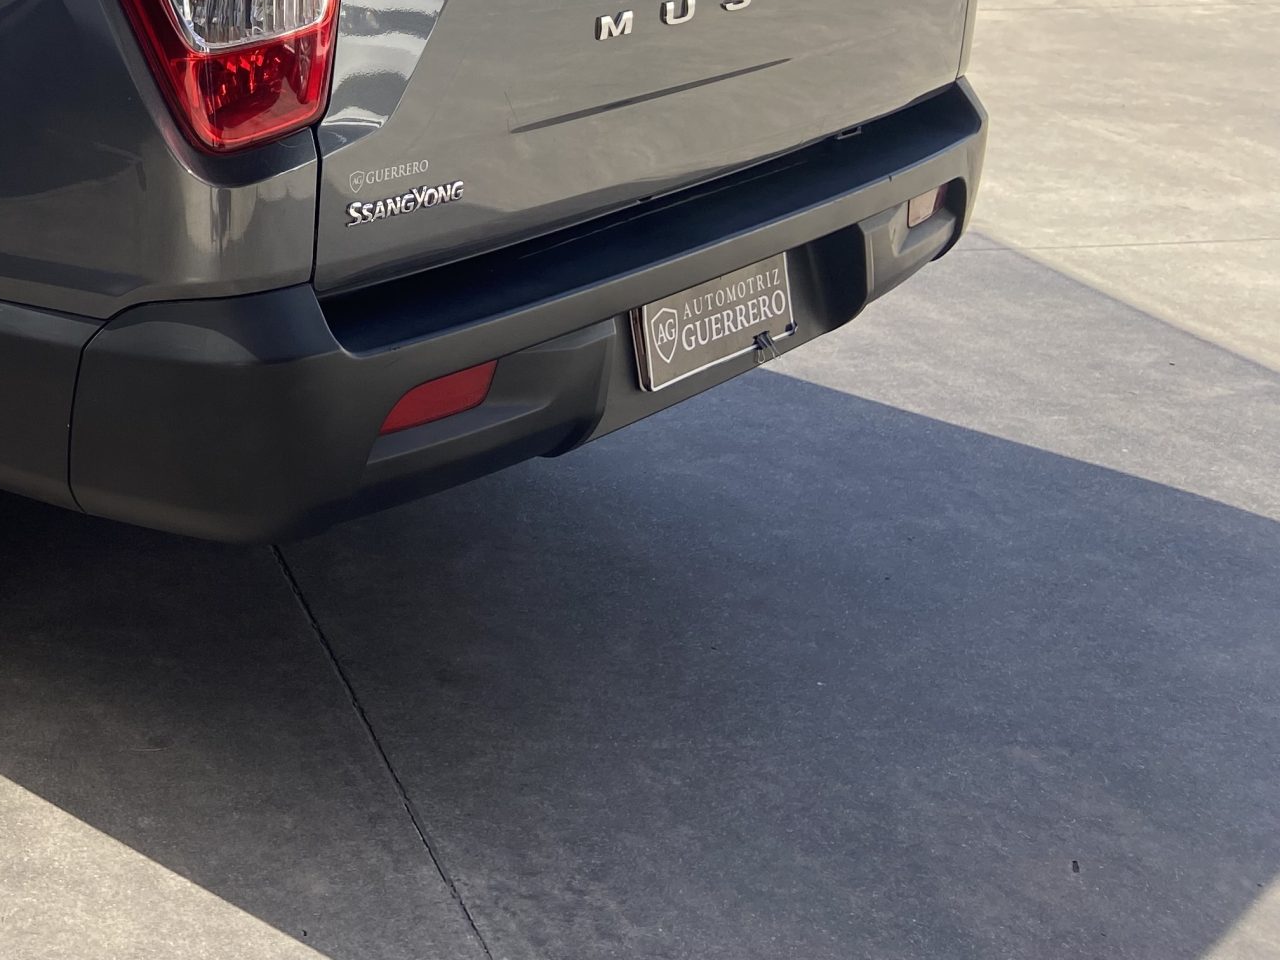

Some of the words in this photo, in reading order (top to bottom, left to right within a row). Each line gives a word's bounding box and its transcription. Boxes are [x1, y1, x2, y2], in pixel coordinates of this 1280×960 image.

[366, 159, 429, 184] GUERRERO
[657, 319, 676, 345] AG
[681, 289, 786, 351] GUERRERO
[683, 268, 781, 320] AUTOMOTRIZ
